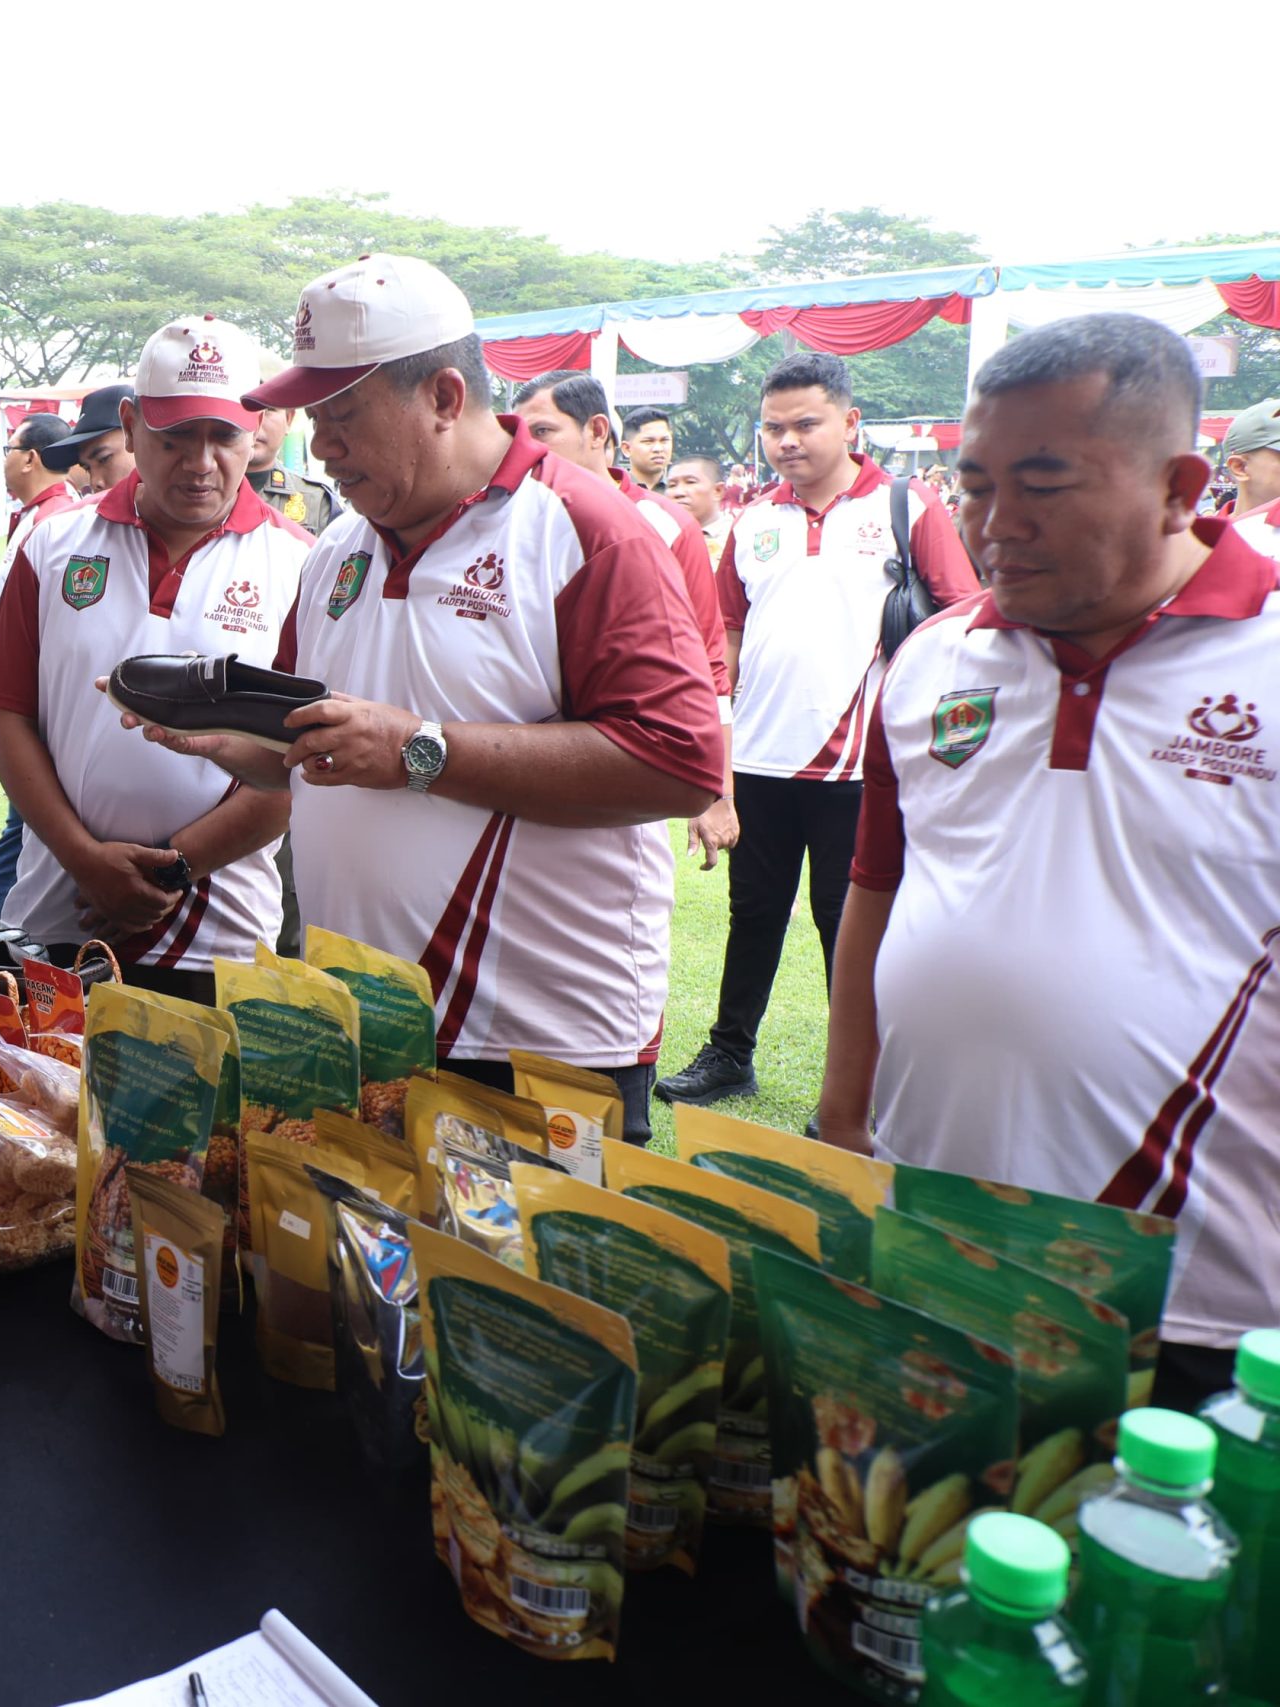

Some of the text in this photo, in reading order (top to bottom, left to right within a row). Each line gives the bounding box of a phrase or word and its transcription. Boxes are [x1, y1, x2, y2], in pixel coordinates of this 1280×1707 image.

[185, 362, 225, 374] JAMBORE
[449, 584, 507, 605] JAMBORE
[213, 604, 265, 623] JAMBORE
[437, 596, 512, 618] KADER POSYANDU
[204, 611, 269, 633] KADER POSYANDU
[1168, 735, 1267, 765] JAMBORE
[26, 980, 56, 997] KACANG
[31, 991, 54, 1006] TOJIN
